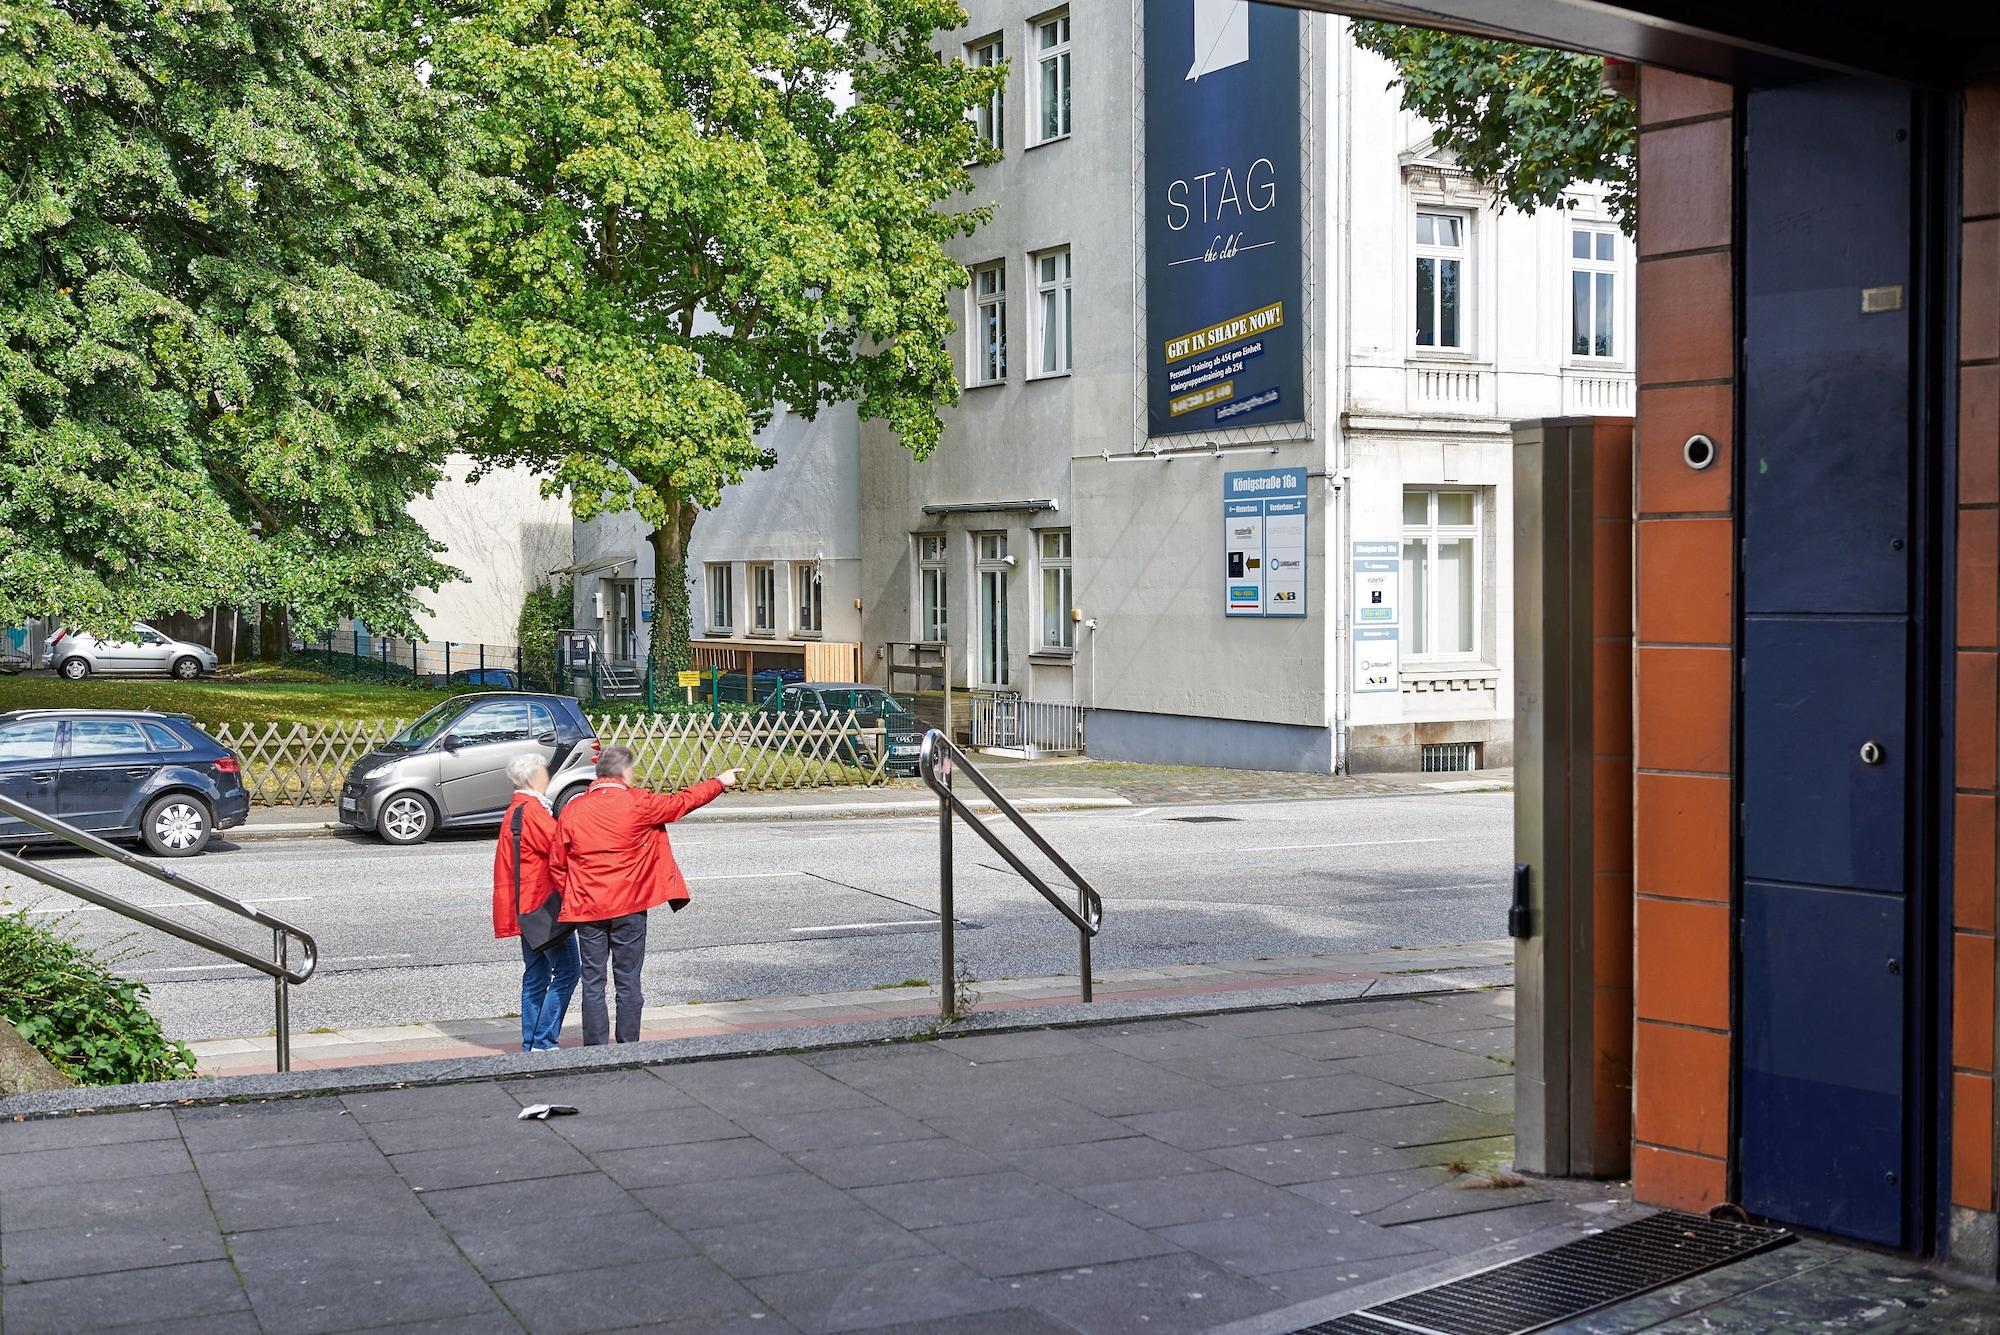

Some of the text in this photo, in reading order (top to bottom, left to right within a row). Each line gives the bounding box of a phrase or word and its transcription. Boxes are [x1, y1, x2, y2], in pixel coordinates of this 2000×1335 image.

[1167, 158, 1275, 231] STAG
[1204, 232, 1243, 262] the club
[1167, 306, 1281, 359] GET IN SHAPE NOW!
[1169, 343, 1262, 380] Personal Training ab 45€ pro Einheit
[1170, 361, 1244, 392] Kleingruppentraining ab 25€
[1232, 473, 1297, 493] Königstraße 16a
[1269, 503, 1294, 512] Vorderhaus
